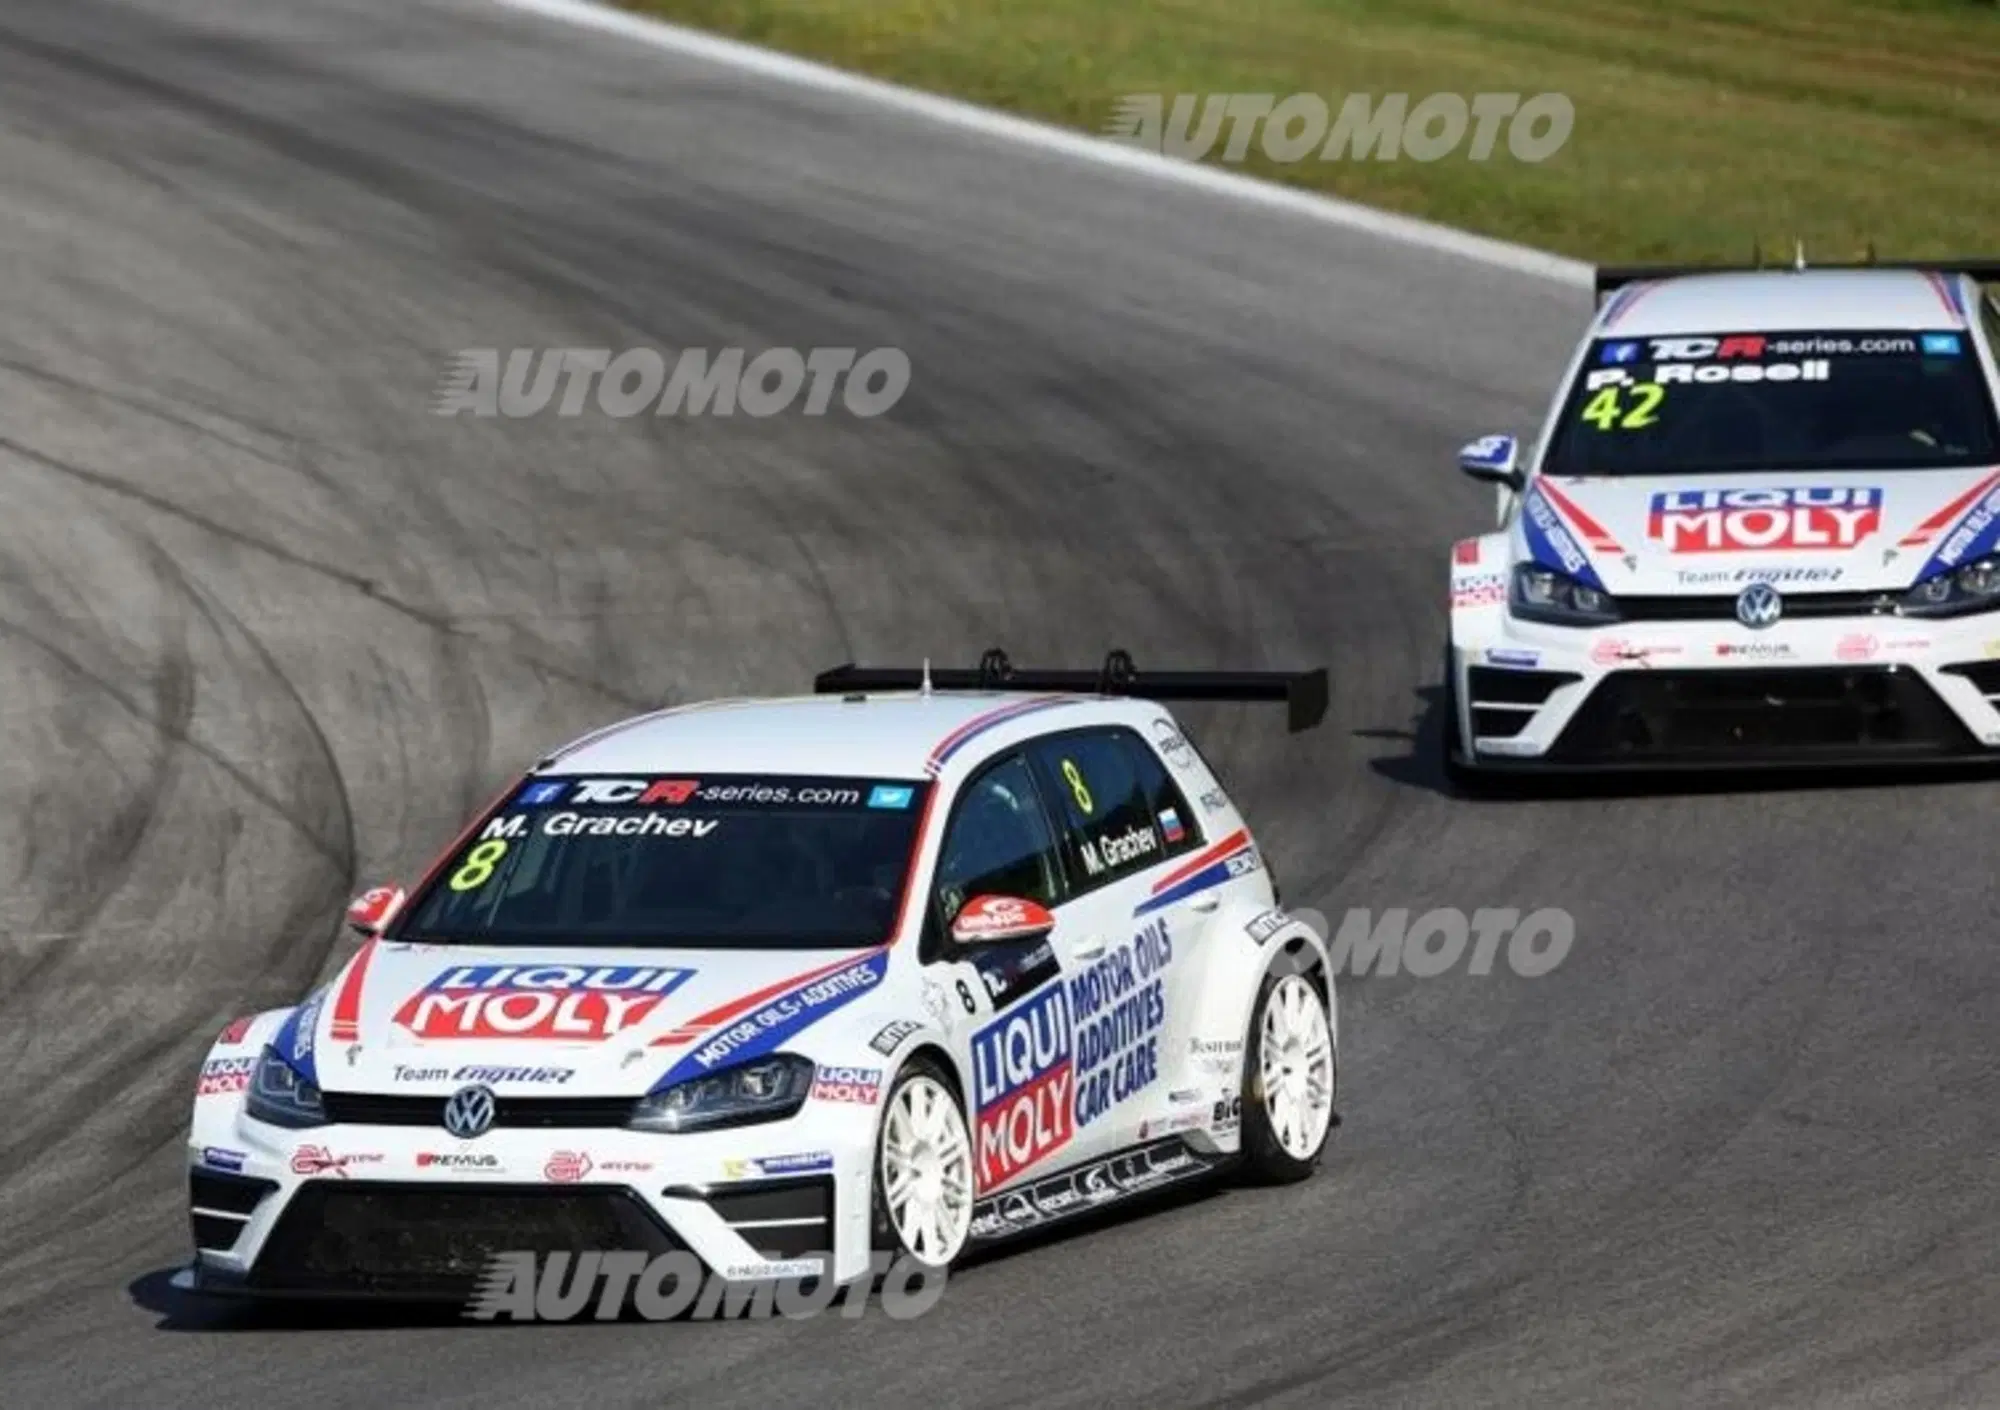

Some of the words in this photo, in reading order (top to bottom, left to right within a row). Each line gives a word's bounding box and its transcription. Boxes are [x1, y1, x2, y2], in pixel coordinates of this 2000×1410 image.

[1586, 369, 1634, 391] P.
[1654, 360, 1830, 384] Rosell
[1581, 384, 1665, 430] 42
[1664, 488, 1871, 510] LIQUI
[1662, 507, 1874, 549] MOLY
[1062, 758, 1094, 816] 8
[481, 815, 526, 839] M.
[543, 811, 719, 838] Grachev
[450, 839, 507, 891] 8
[1079, 841, 1106, 876] M.
[1100, 824, 1157, 866] Grachev
[441, 968, 681, 991] LIQUI
[956, 978, 976, 1015] 8
[1070, 951, 1135, 1024] MOTOR
[1135, 926, 1173, 980] OILS
[411, 991, 660, 1035] MOLY
[1076, 979, 1165, 1076] ADDITIVES
[693, 1022, 757, 1068] MOTOR
[975, 988, 1071, 1105] LIQUI
[394, 1065, 448, 1082] Team
[813, 1083, 879, 1102] MOLY
[1075, 1064, 1113, 1128] CAR
[1113, 1036, 1158, 1102] CARE
[976, 1068, 1072, 1185] MOLY
